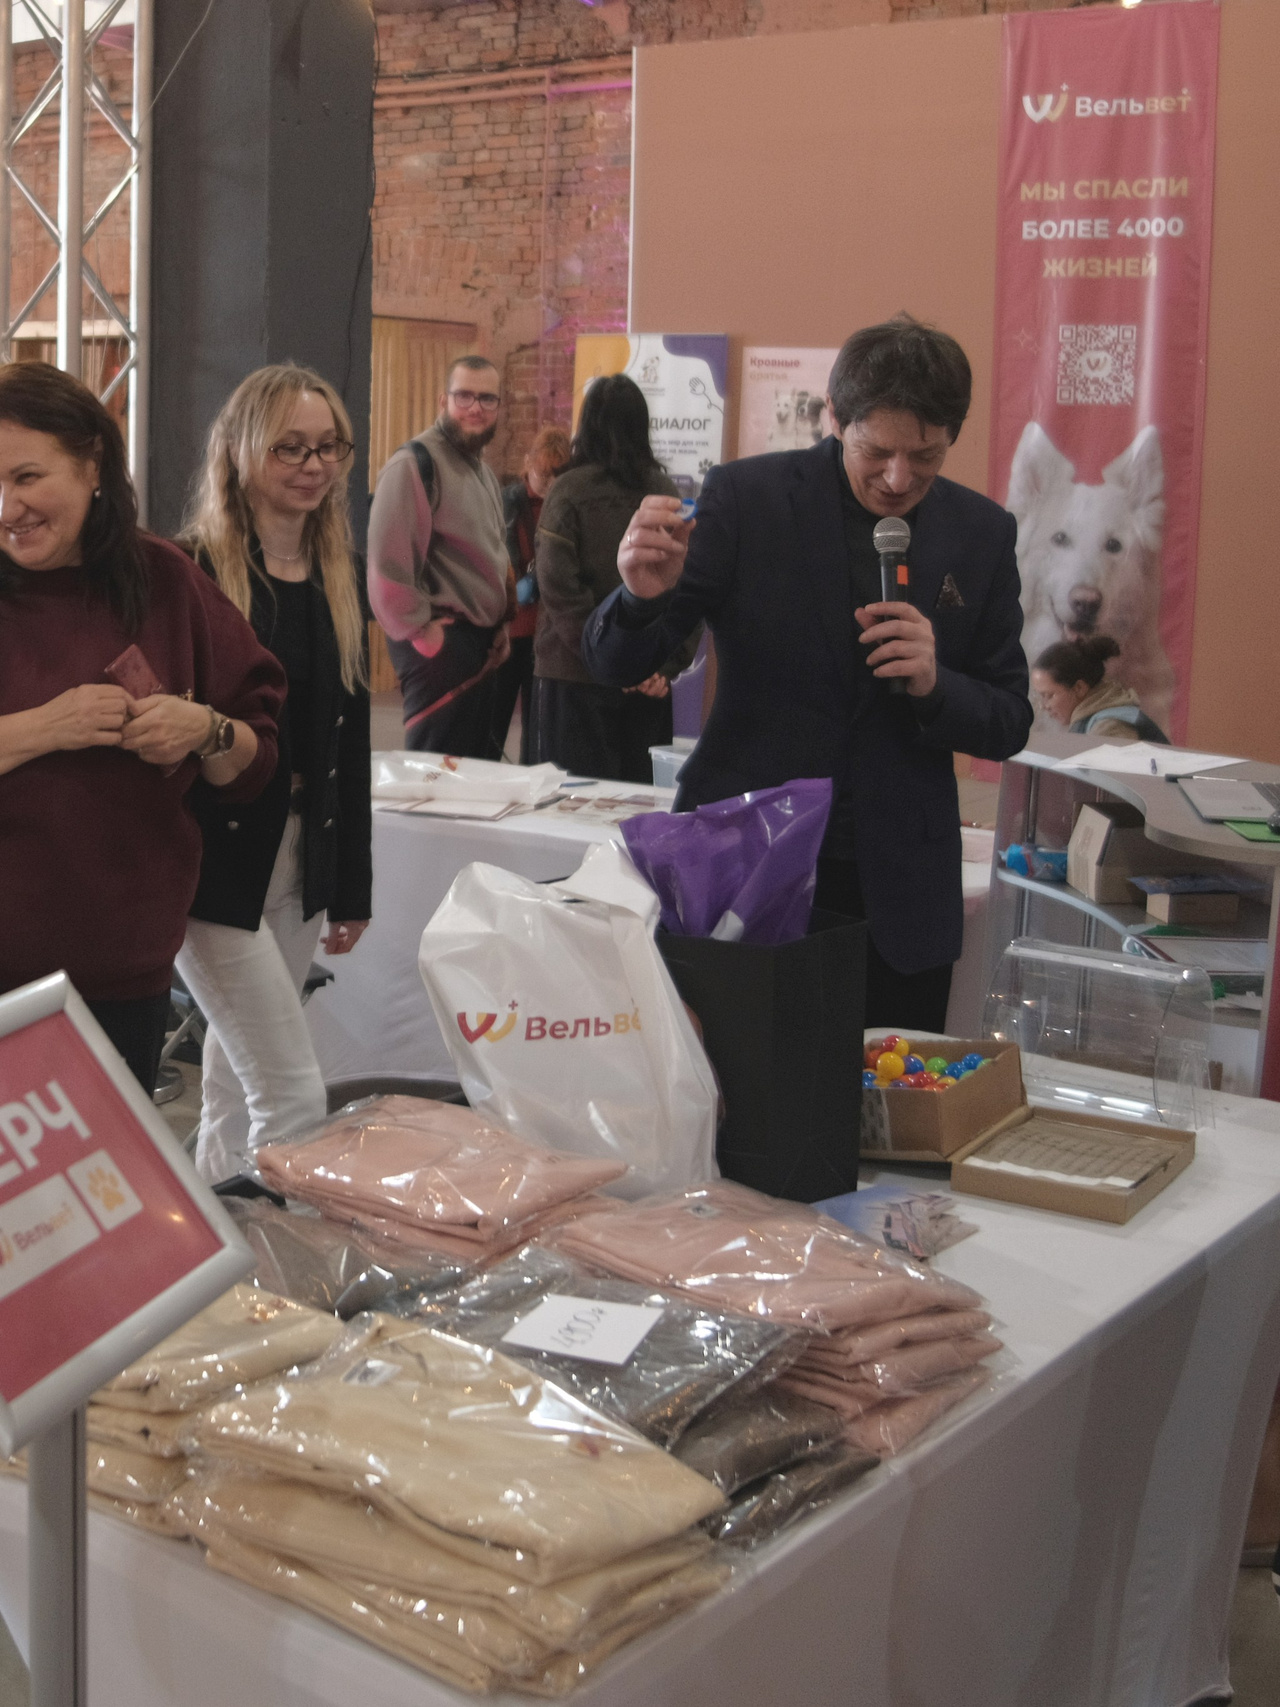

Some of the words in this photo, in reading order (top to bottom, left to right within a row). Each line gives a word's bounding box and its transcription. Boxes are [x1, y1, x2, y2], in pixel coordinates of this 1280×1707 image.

[1075, 93, 1191, 118] Вельвет
[1020, 181, 1065, 202] МЫ
[1073, 177, 1188, 200] СПАСЛИ
[1022, 219, 1110, 240] БОЛЕЕ
[1117, 217, 1184, 239] 4000
[1043, 253, 1157, 278] ЖИЗНЕЙ
